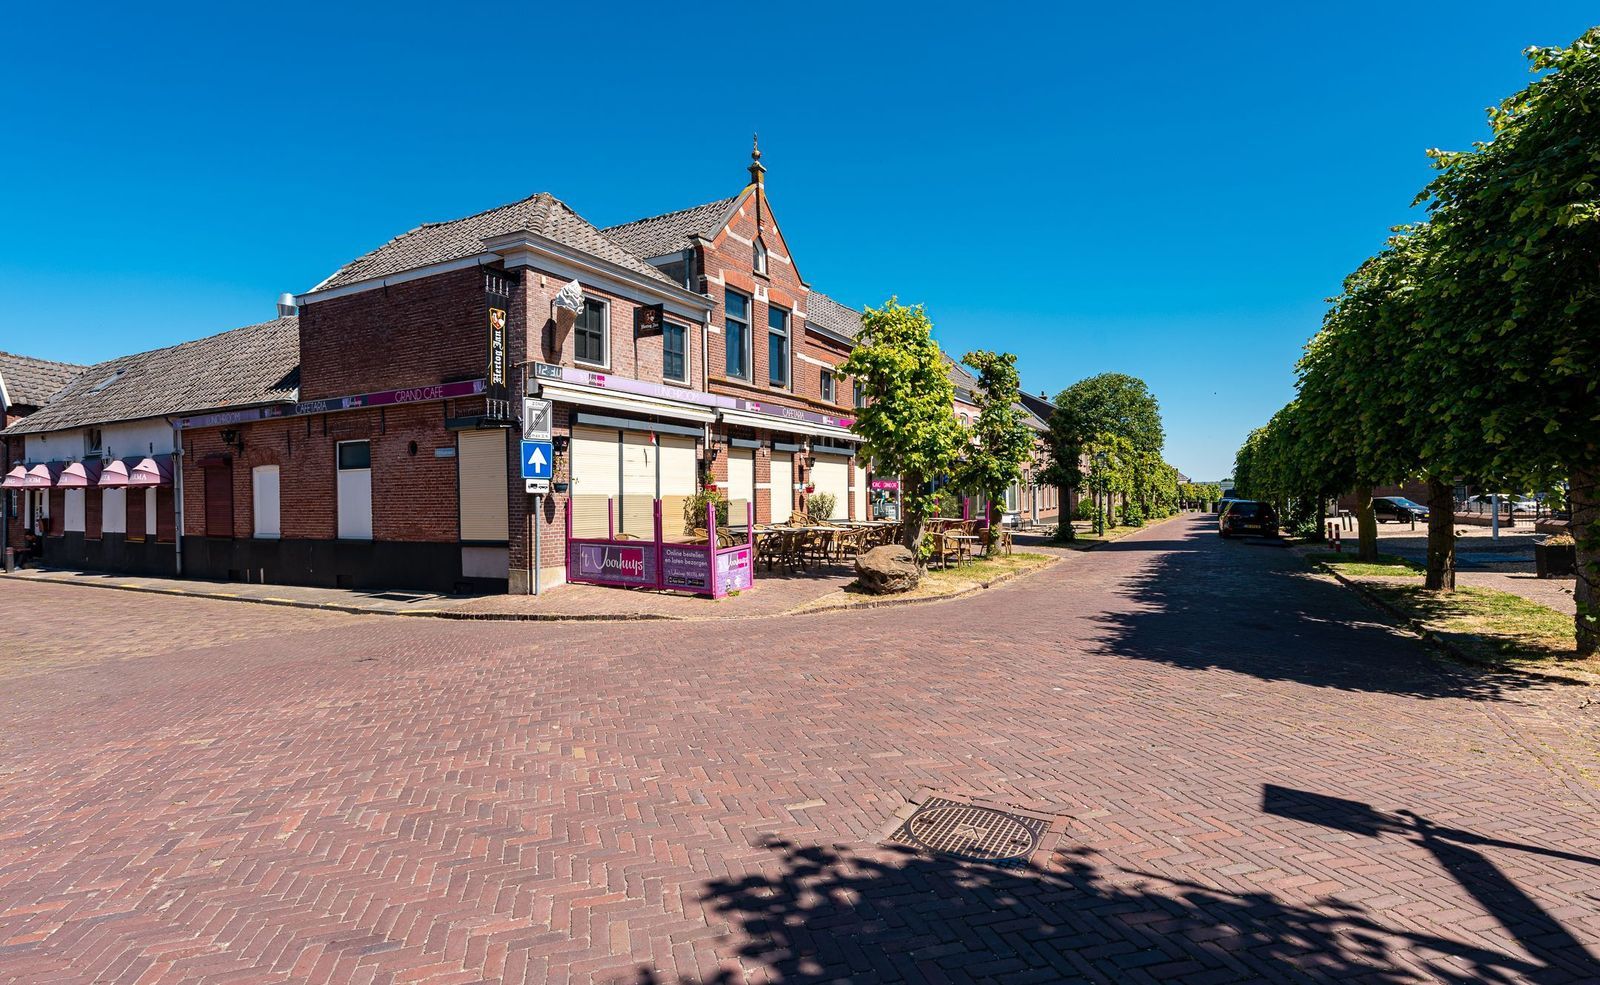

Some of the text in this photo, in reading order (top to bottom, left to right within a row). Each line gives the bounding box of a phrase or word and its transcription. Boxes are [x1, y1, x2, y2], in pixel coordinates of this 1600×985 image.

[493, 330, 503, 384] Hertog Jan
[395, 388, 422, 402] GRAND
[295, 401, 327, 414] CAFETARIA
[591, 546, 643, 575] Voorhuys
[666, 549, 704, 559] Online bestellen
[684, 558, 708, 567] bezorgen
